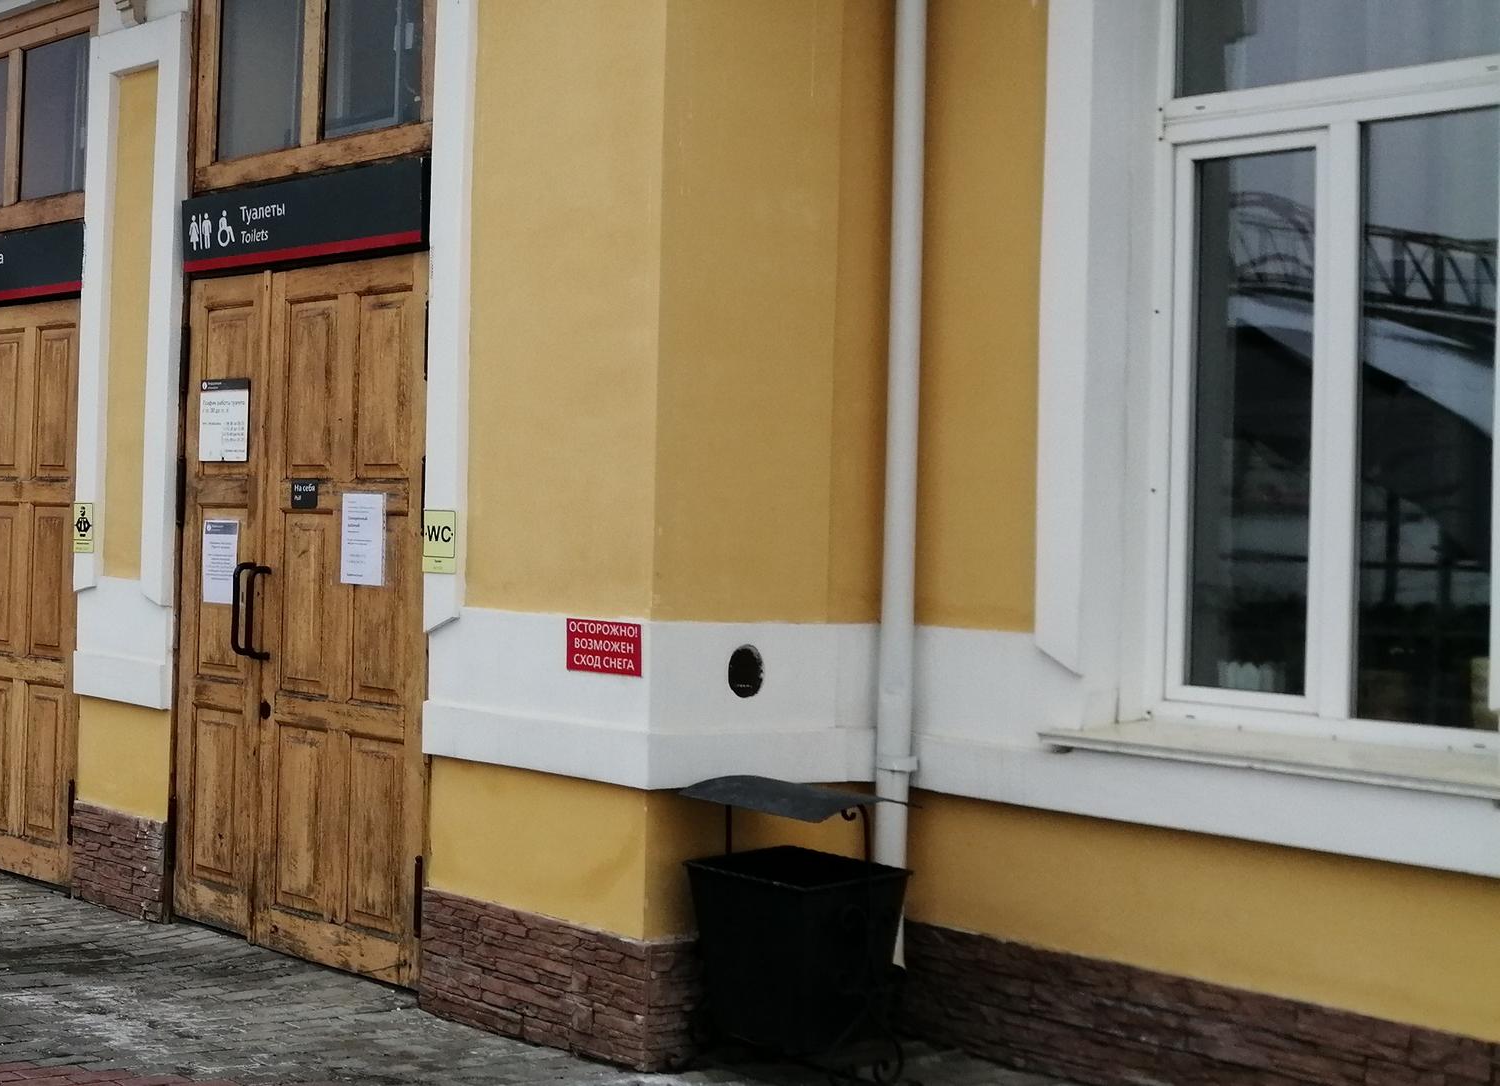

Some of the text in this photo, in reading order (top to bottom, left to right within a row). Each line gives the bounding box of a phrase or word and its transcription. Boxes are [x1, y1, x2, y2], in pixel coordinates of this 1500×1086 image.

[239, 203, 286, 225] Туалеты
[240, 228, 269, 244] Toilets
[302, 483, 316, 491] себя
[427, 525, 452, 543] WC
[569, 621, 639, 638] ОСТОРОЖНО!
[574, 637, 634, 654] ВОЗМОЖЕН
[573, 653, 635, 671] СХОД СНЕГА
